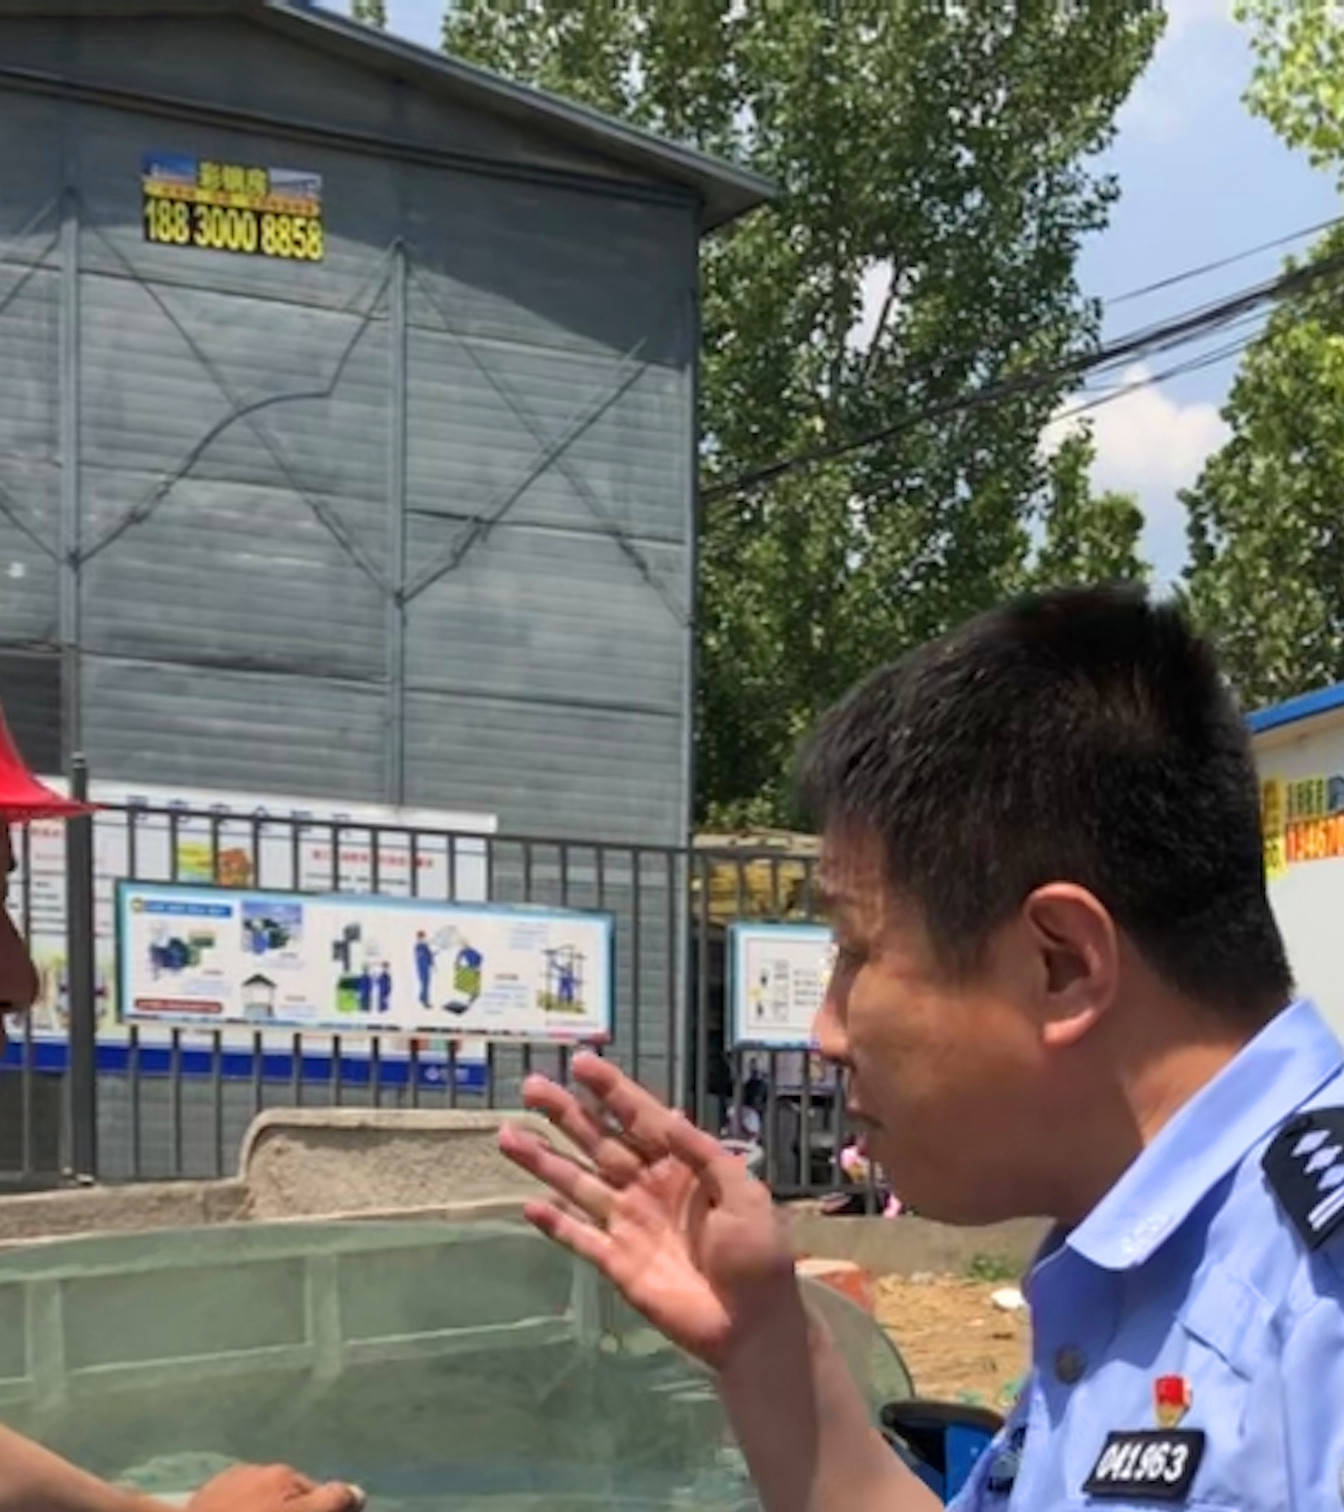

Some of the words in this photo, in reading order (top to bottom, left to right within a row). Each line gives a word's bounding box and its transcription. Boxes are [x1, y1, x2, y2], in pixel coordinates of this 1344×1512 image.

[144, 198, 191, 245] 188
[193, 204, 259, 254] 3000
[260, 213, 324, 261] 8858
